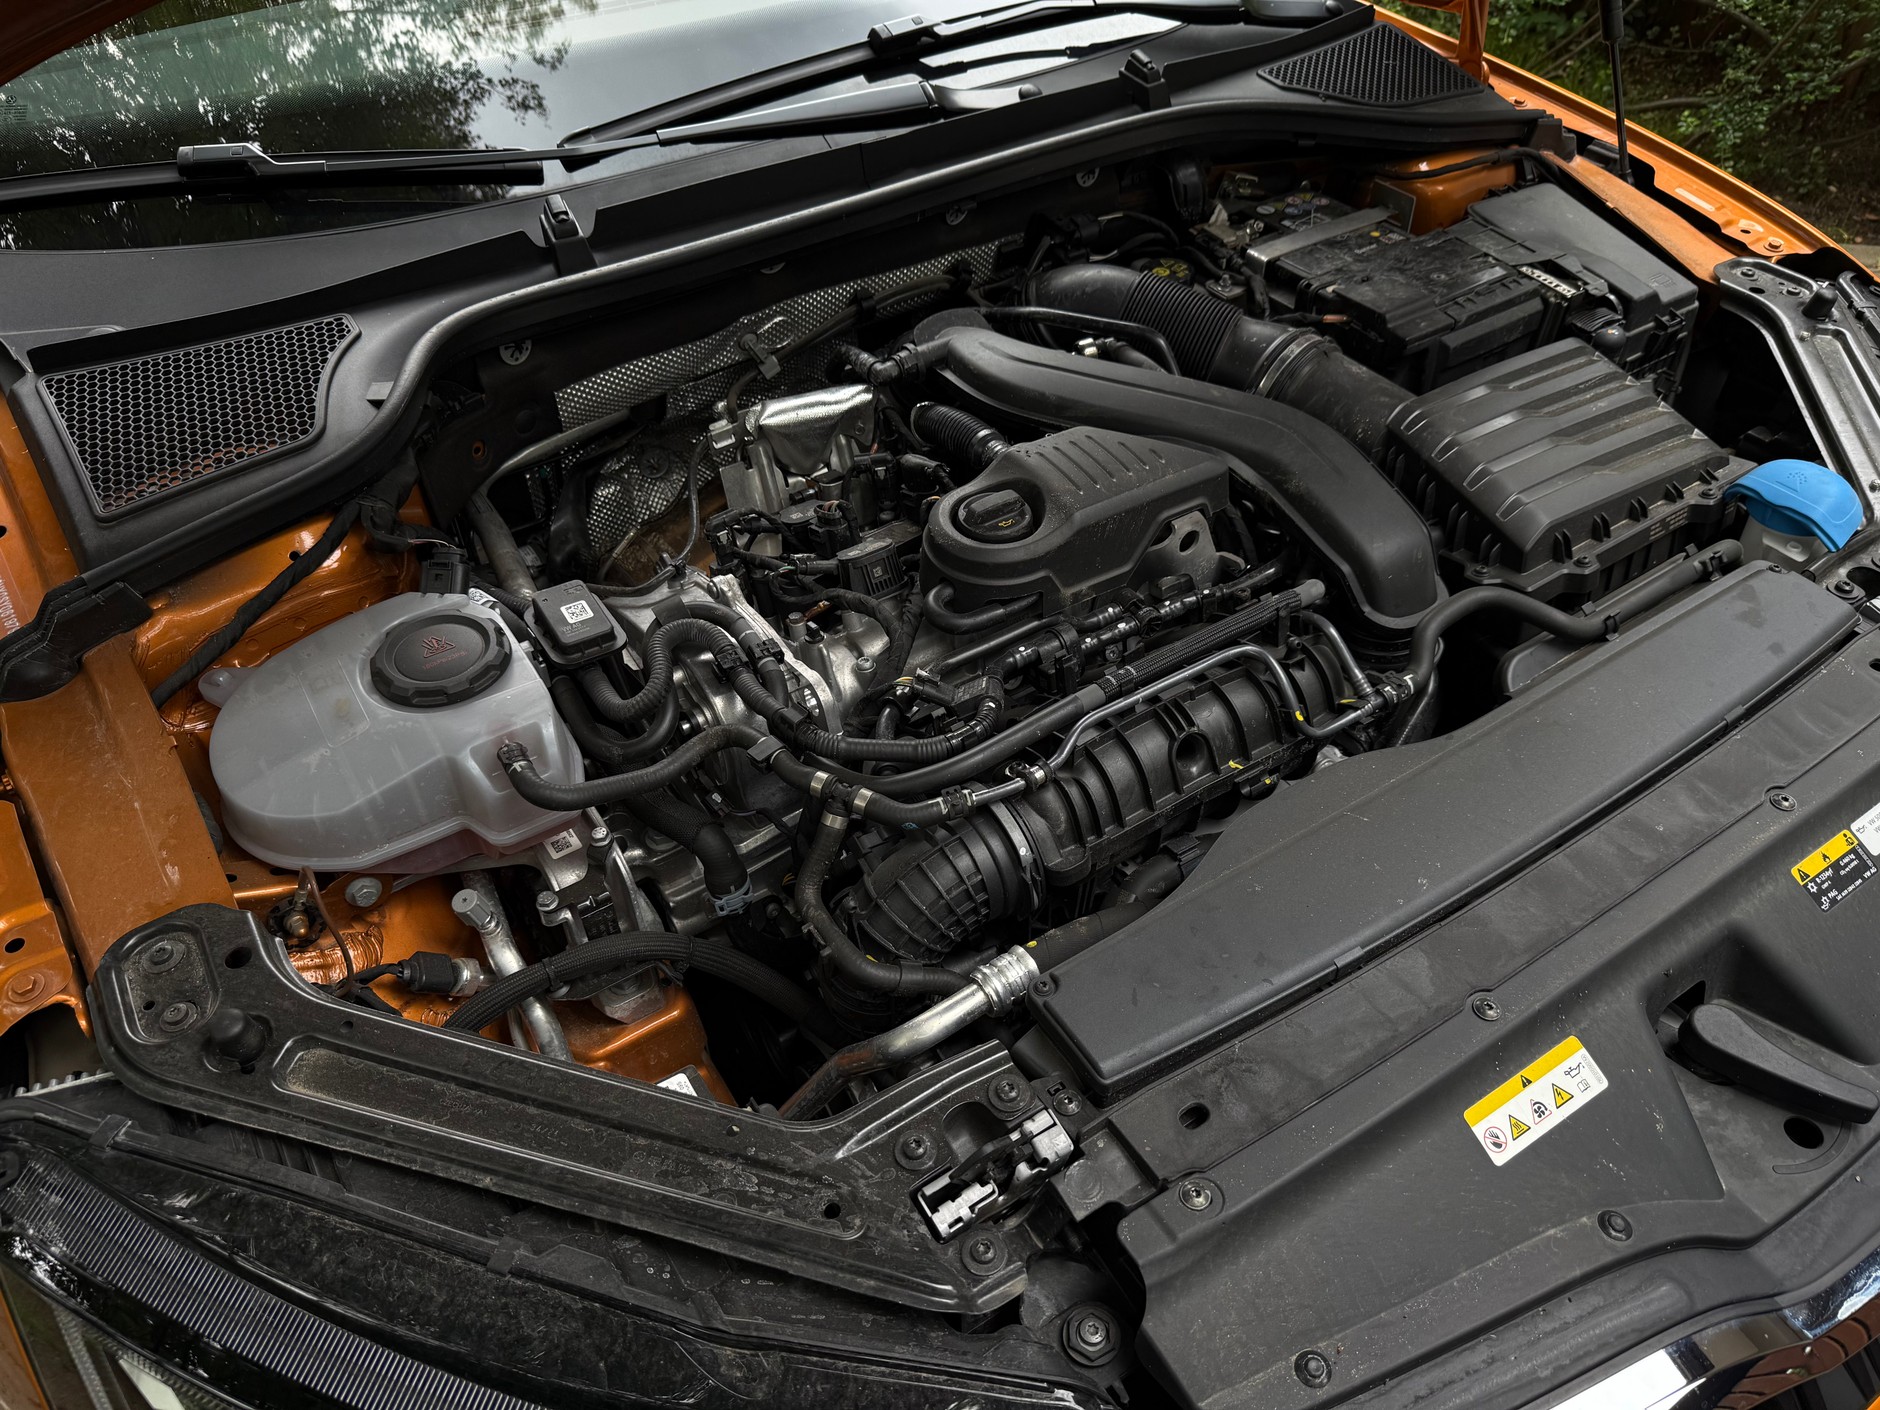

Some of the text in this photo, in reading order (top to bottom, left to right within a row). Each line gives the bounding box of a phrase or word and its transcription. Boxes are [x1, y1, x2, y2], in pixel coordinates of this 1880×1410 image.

[1815, 867, 1833, 883] R-1234yf
[1863, 866, 1877, 878] VW AG
[1828, 889, 1838, 899] PAG
